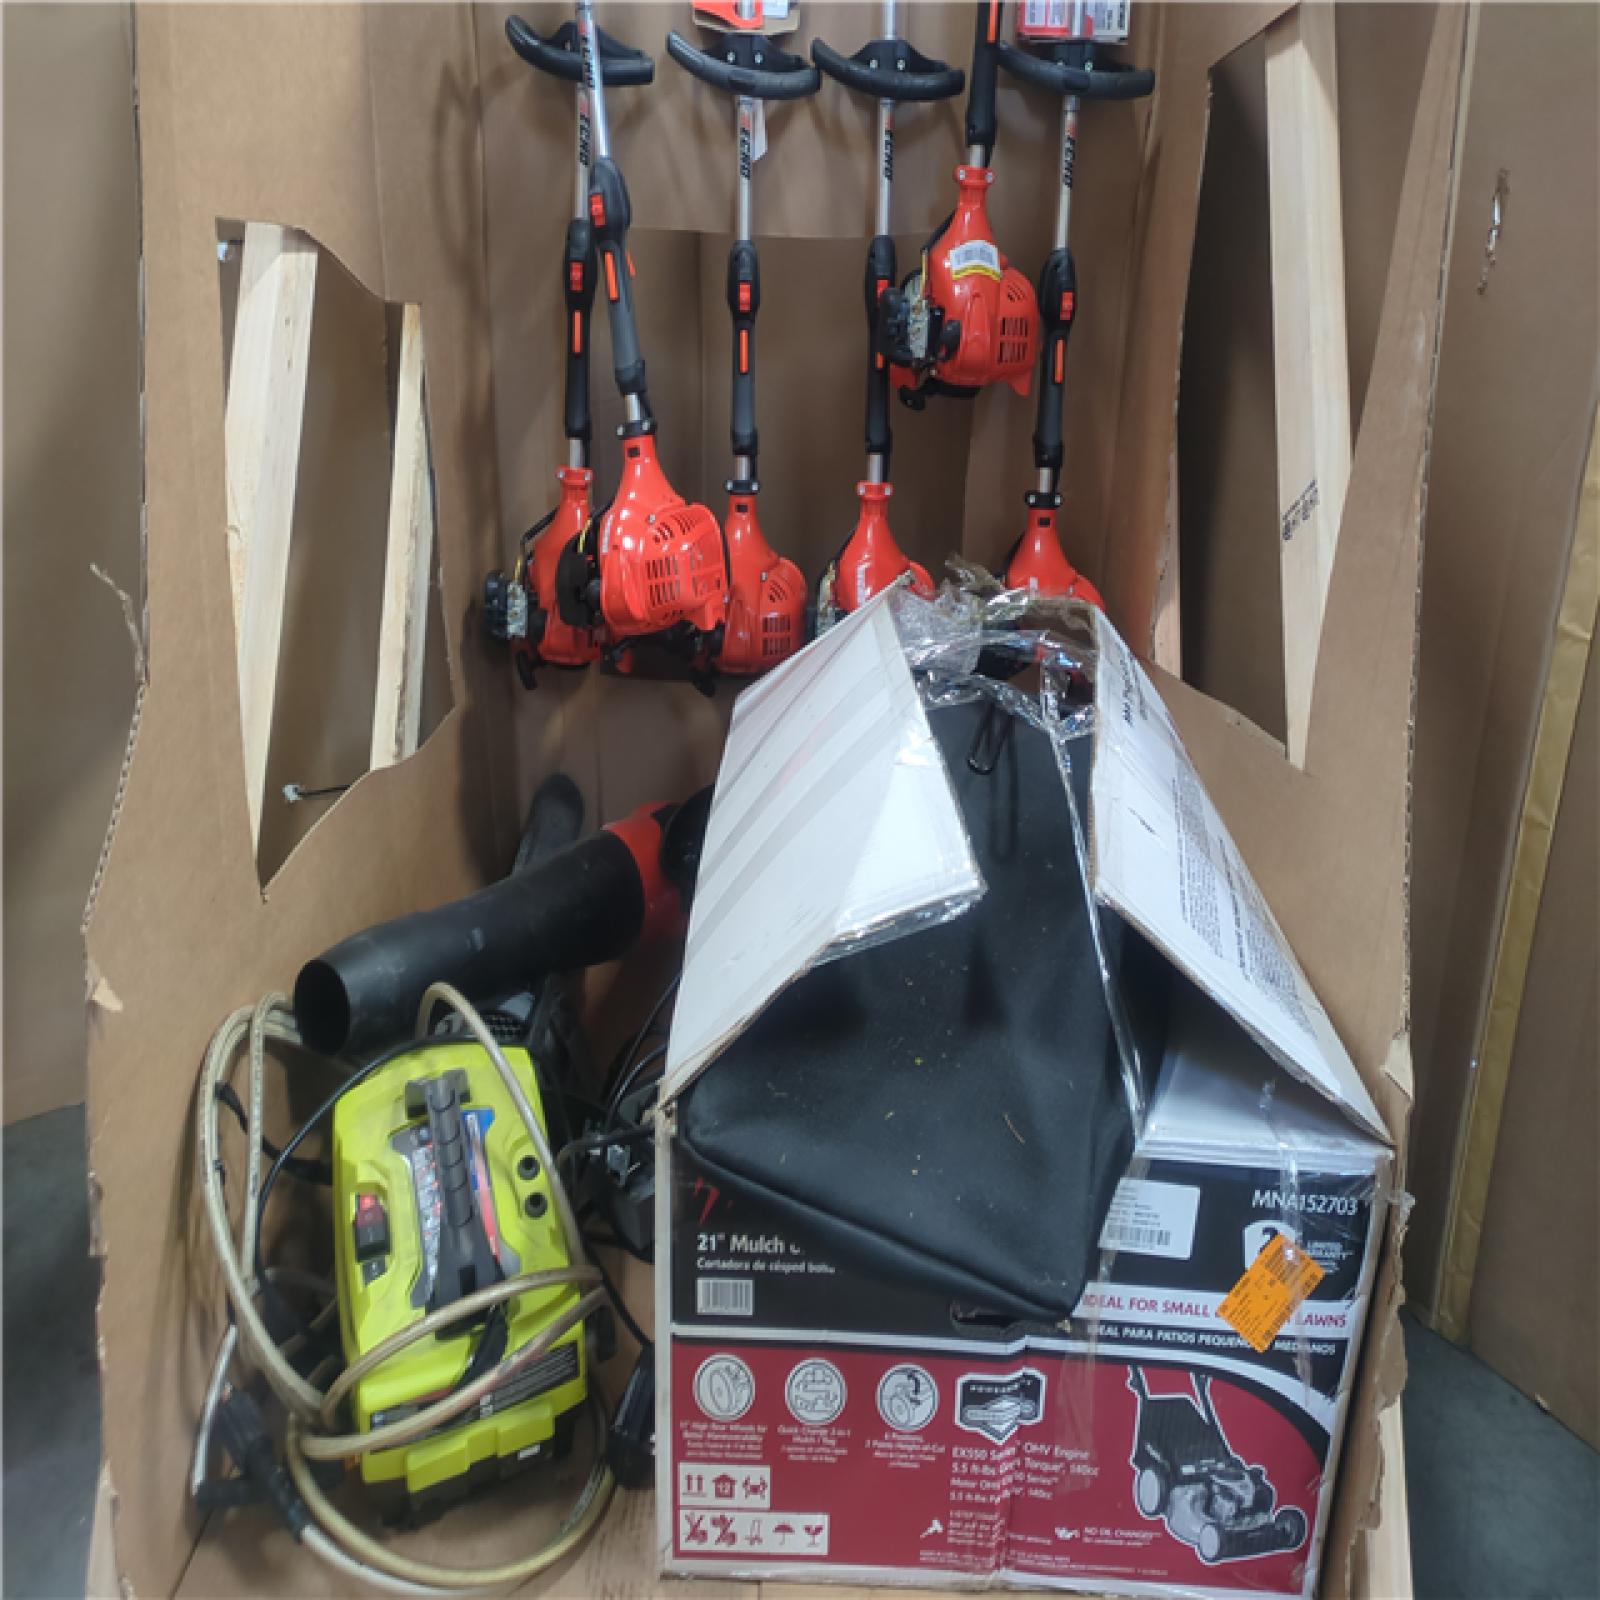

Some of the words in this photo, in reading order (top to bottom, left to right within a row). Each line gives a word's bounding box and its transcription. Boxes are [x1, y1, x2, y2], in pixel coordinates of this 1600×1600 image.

[579, 113, 591, 167] ECHO
[740, 126, 752, 180] ECHO
[883, 129, 894, 180] ECHO
[1062, 136, 1076, 188] ECHO
[1251, 1189, 1359, 1216] MNA152703
[729, 1233, 785, 1254] Mulch
[1083, 1291, 1124, 1311] IDEAL
[1129, 1295, 1158, 1313] FOR
[1162, 1298, 1211, 1319] SMALL
[1122, 1325, 1153, 1341] PARA
[1156, 1328, 1197, 1345] PATIOS
[951, 1461, 968, 1474] 5.5
